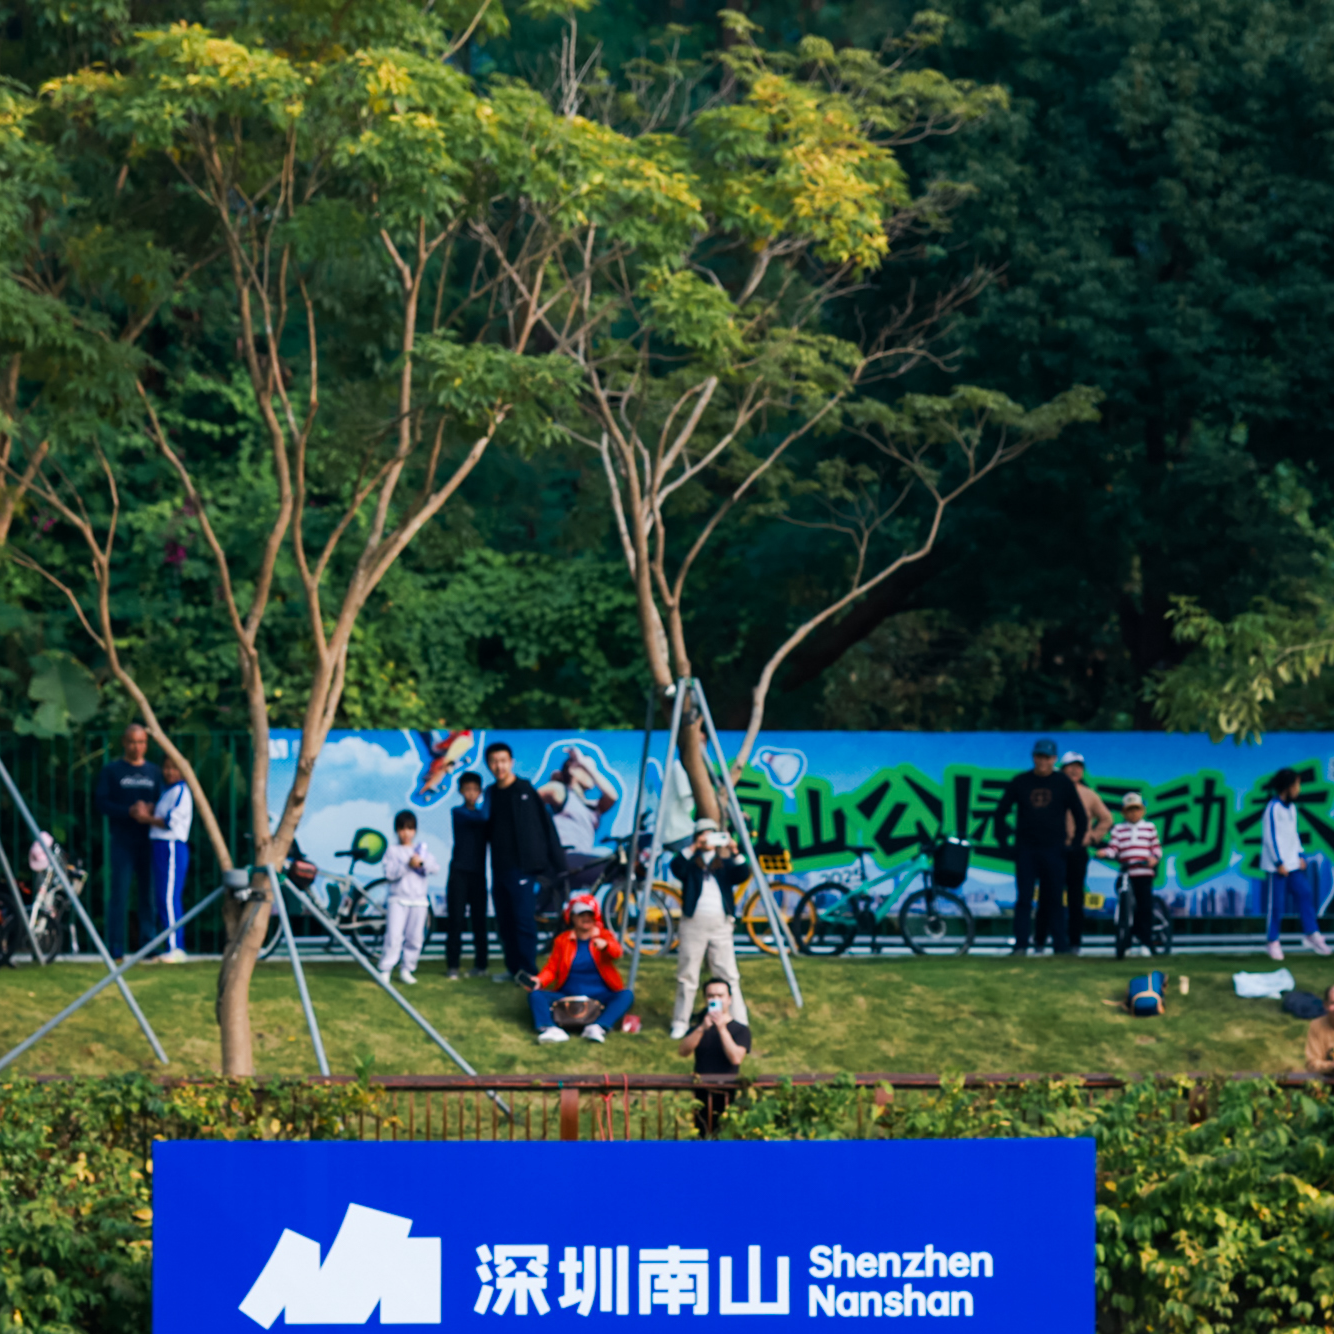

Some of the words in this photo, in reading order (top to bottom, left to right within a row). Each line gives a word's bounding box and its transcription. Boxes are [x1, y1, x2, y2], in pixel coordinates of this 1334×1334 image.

[808, 1244, 993, 1278] Shenzhen
[473, 1244, 790, 1316] 深圳南山
[808, 1284, 974, 1317] Nanshan
